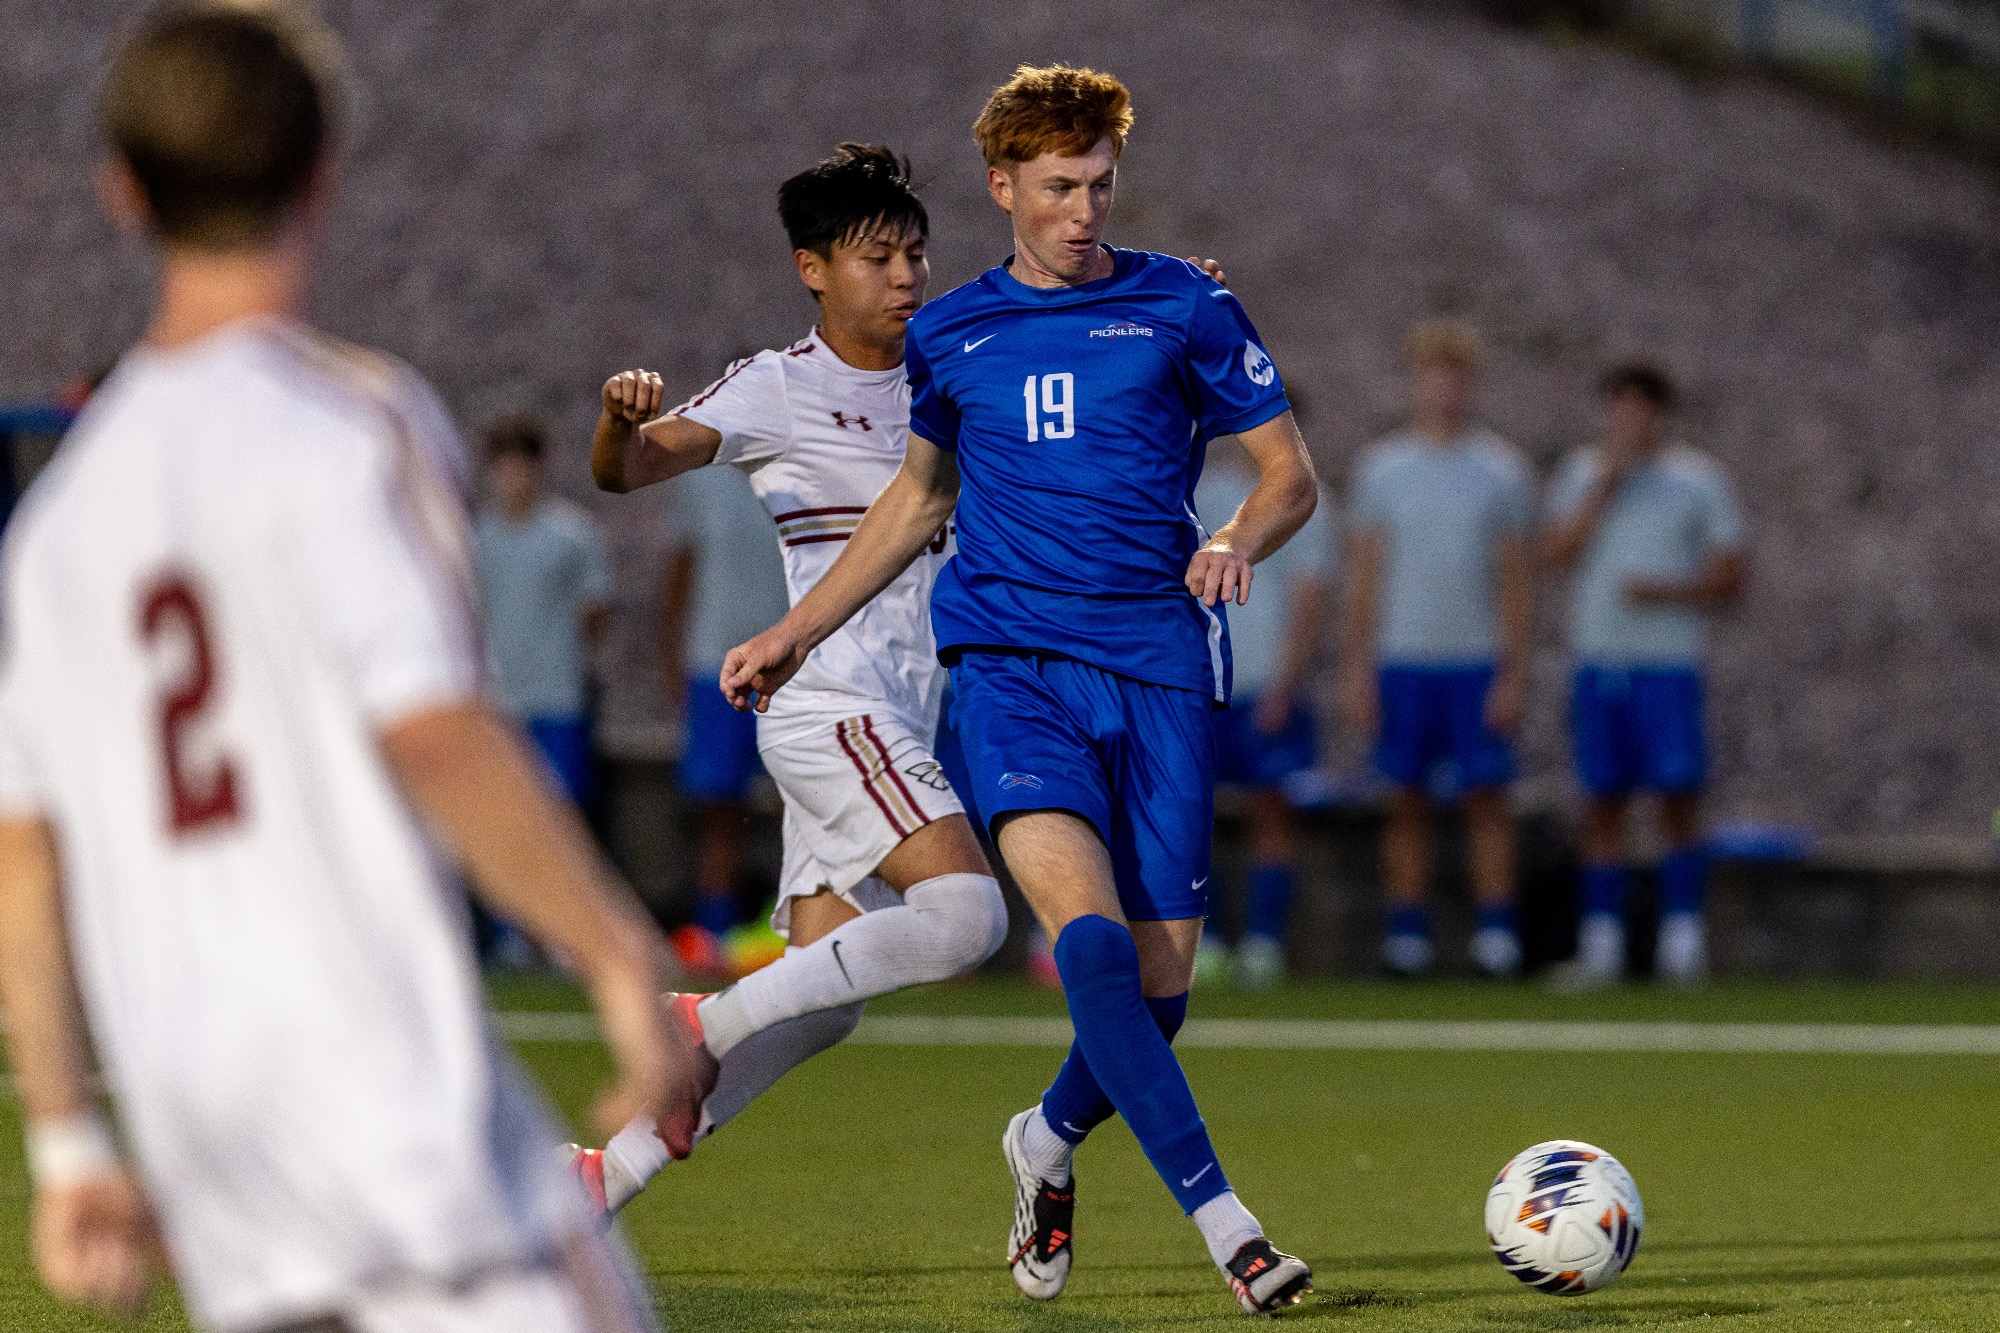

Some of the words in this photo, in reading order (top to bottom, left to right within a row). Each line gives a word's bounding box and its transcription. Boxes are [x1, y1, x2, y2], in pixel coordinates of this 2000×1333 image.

[1089, 327, 1154, 338] PIONEERS
[1023, 372, 1075, 443] 19
[137, 570, 250, 840] 2
